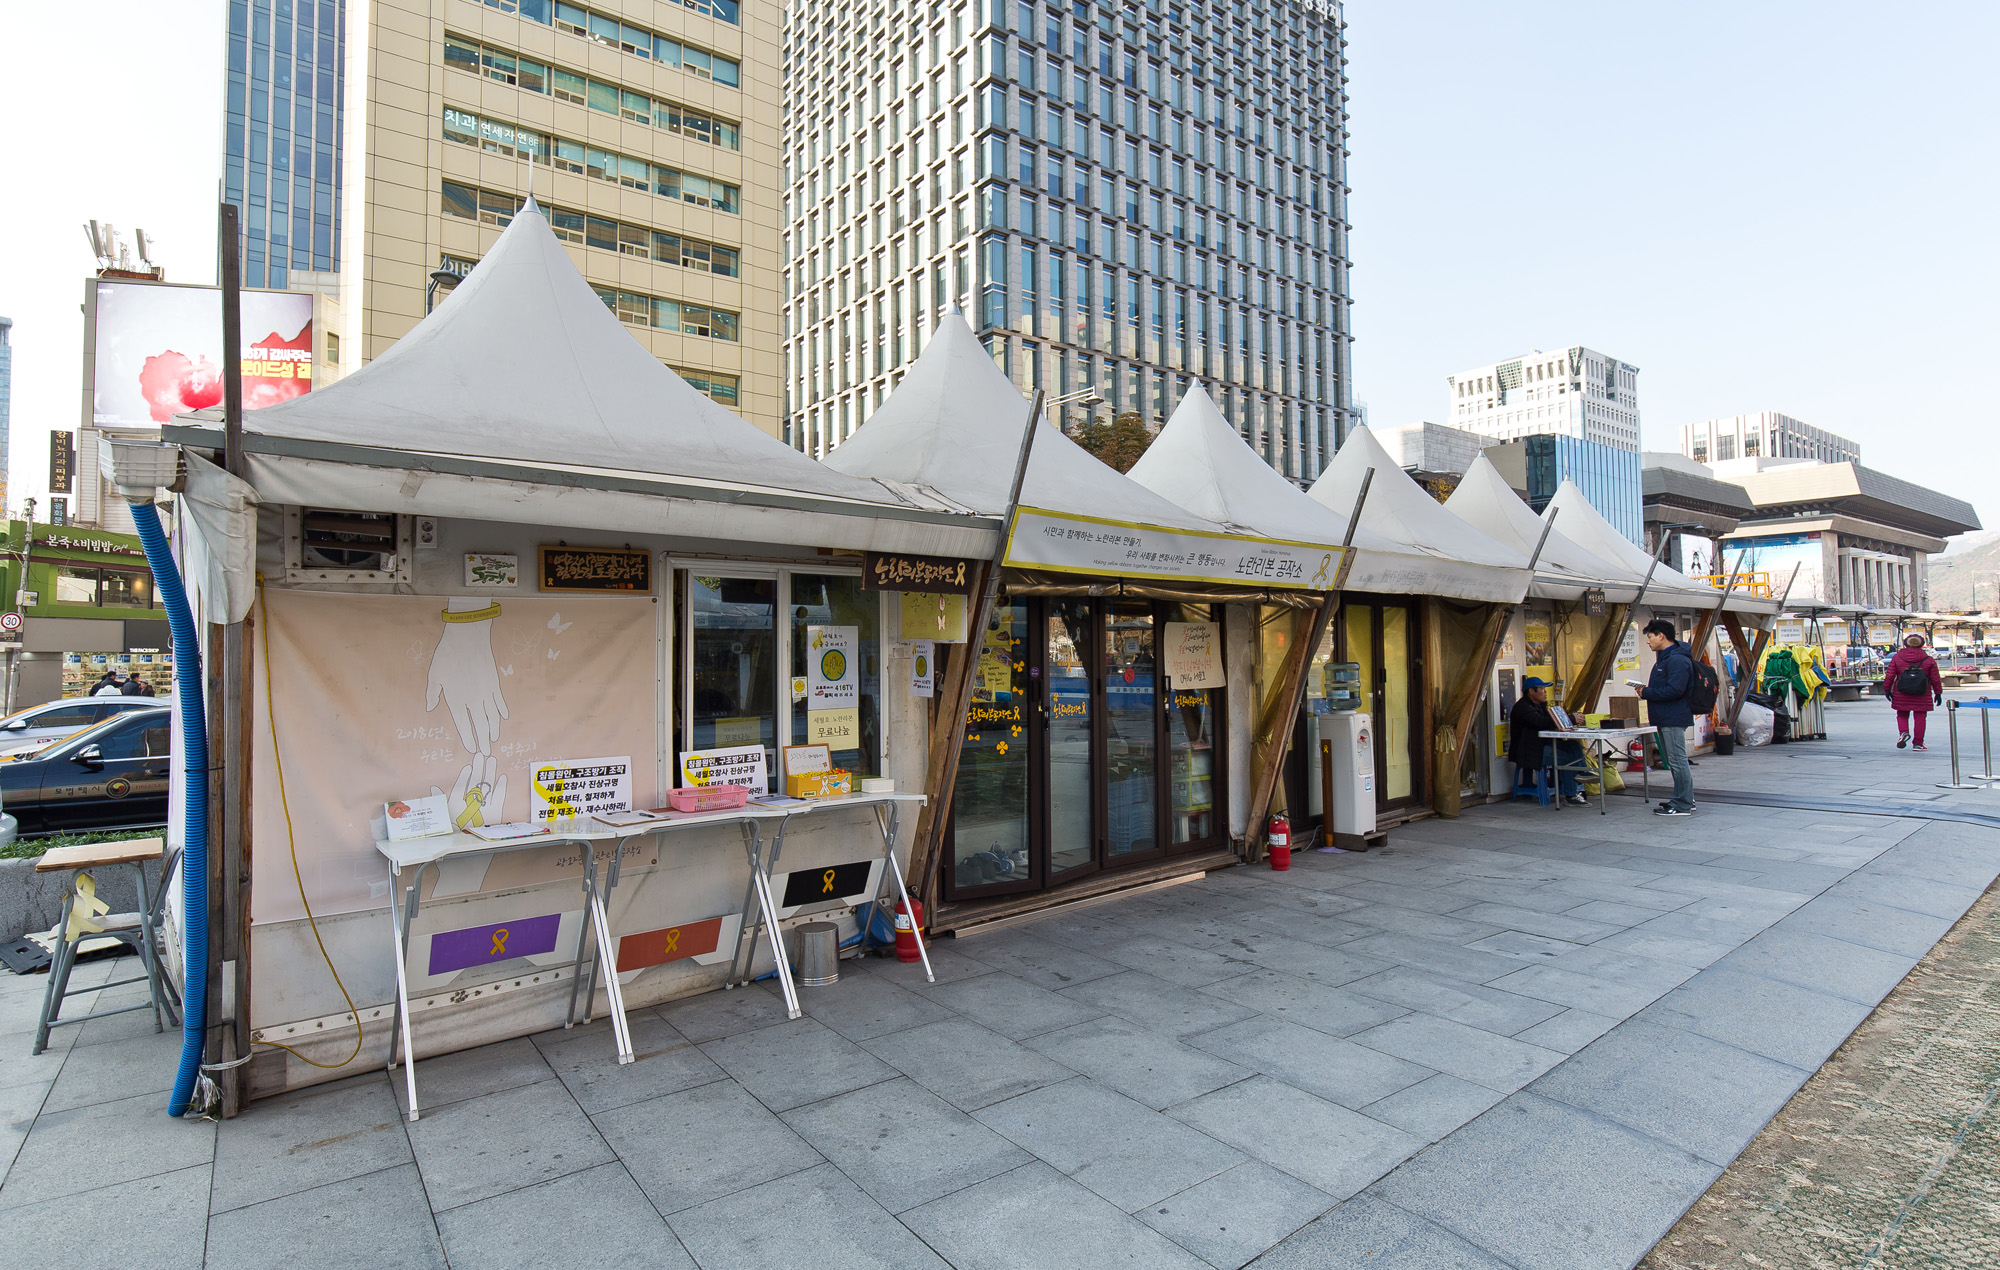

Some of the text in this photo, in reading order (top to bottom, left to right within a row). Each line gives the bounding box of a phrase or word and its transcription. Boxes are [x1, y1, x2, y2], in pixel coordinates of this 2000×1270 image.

[1304, 0, 1342, 29] 화재
[444, 108, 540, 147] 치과 연세자연 8F
[269, 348, 312, 363] 감싸주는
[241, 360, 295, 379] 로이드성
[55, 467, 67, 490] 피부과
[1043, 526, 1065, 538] 시민과
[1066, 529, 1094, 542] 함께하는
[1095, 533, 1122, 546] 노란리본
[1093, 559, 1107, 567] Making
[1126, 549, 1139, 560] 우리
[1139, 552, 1157, 562] 사회를
[1158, 553, 1185, 564] 변화시키는
[1186, 552, 1196, 565] 큰
[874, 557, 955, 585] 노란리본공작소
[1235, 556, 1303, 579] 노란리본 공작소
[5, 616, 18, 627] 30
[832, 714, 854, 723] 노란리본
[817, 725, 851, 738] 무료나눔
[420, 749, 454, 764] 우리는
[687, 753, 760, 769] 침몰원인, 구조방기 조작
[539, 765, 625, 781] 침몰원인, 구조방기 조작
[694, 765, 756, 779] 세월호참사 진상규명
[55, 785, 101, 796] 모범택시
[546, 778, 619, 792] 세월호참사 진상규명
[548, 790, 616, 805] 처음부터, 철저하게
[538, 801, 627, 819] 전면 재조사, 재수사하라!
